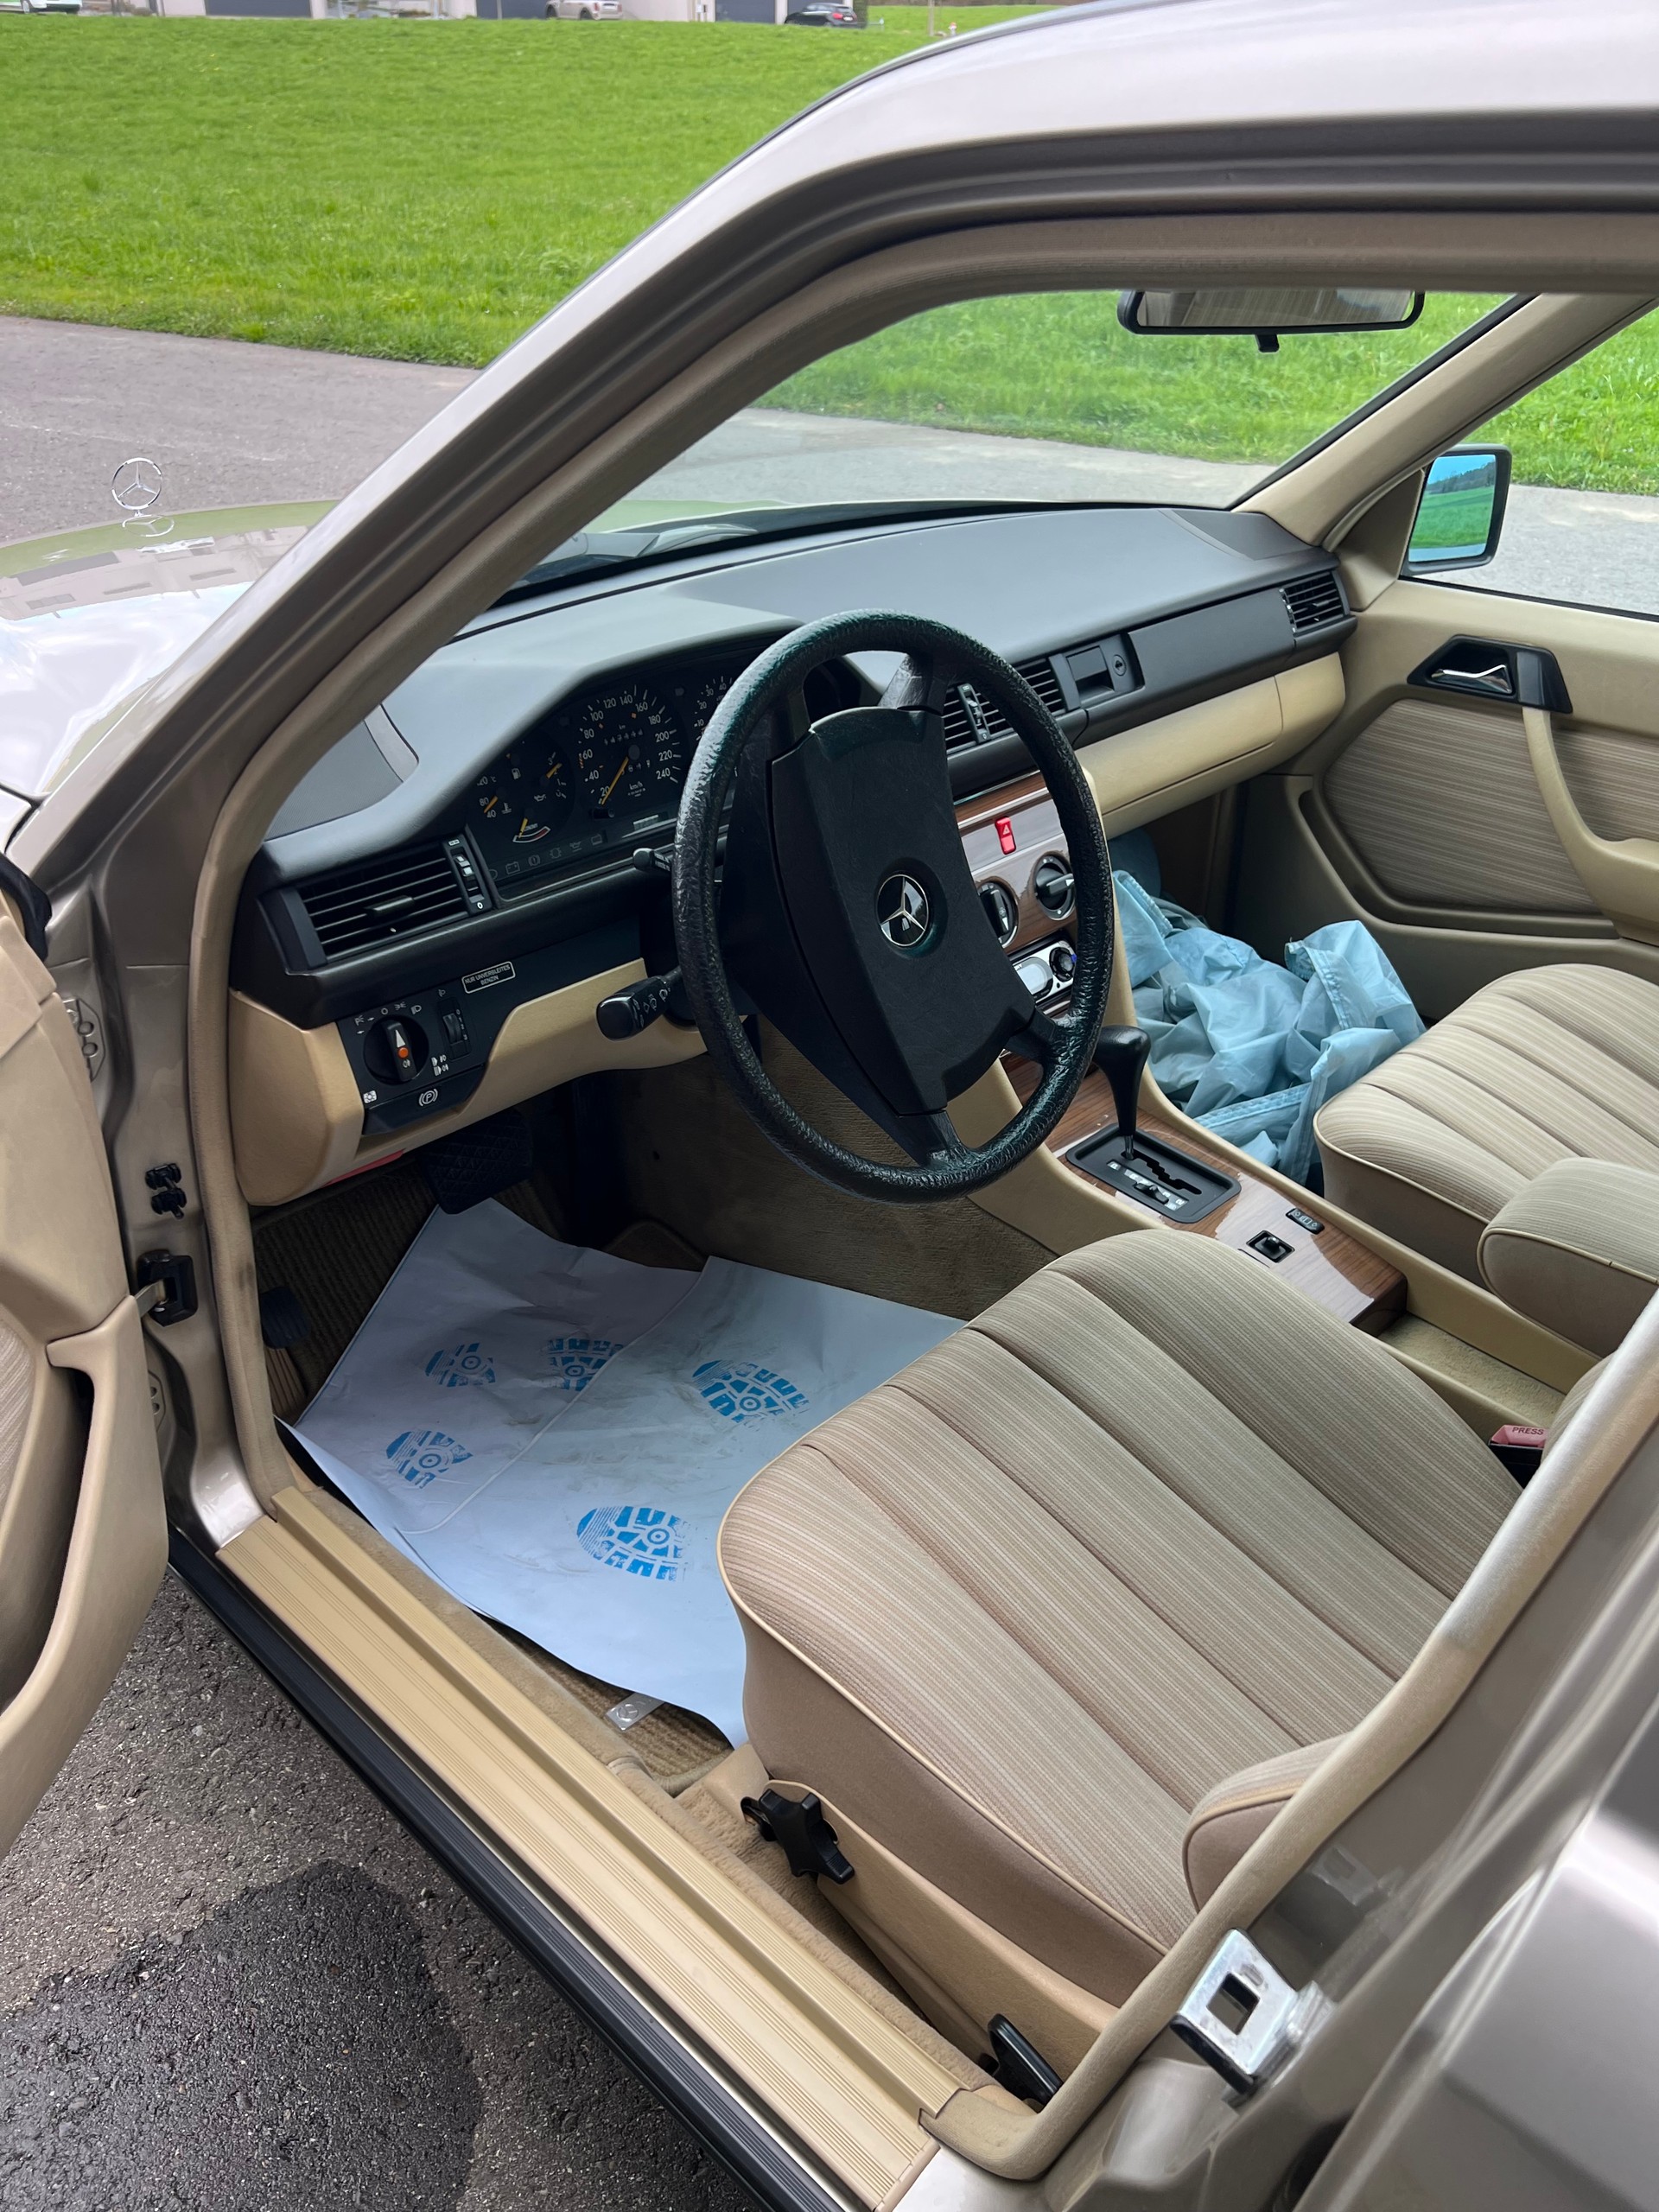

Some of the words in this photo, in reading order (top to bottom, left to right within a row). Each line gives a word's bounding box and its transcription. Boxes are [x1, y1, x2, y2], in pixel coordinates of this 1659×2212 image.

[603, 697, 616, 709] 120
[620, 695, 633, 705] 140
[635, 702, 648, 712] 160
[590, 710, 604, 721] 100
[648, 715, 661, 725] 180
[583, 728, 594, 739] 80
[655, 731, 670, 742] 200
[582, 748, 593, 760] 60
[658, 749, 672, 761] 220
[589, 769, 599, 780] 40
[656, 767, 671, 779] 240
[480, 975, 499, 985] BENZIN
[1512, 1427, 1544, 1435] PRESS
